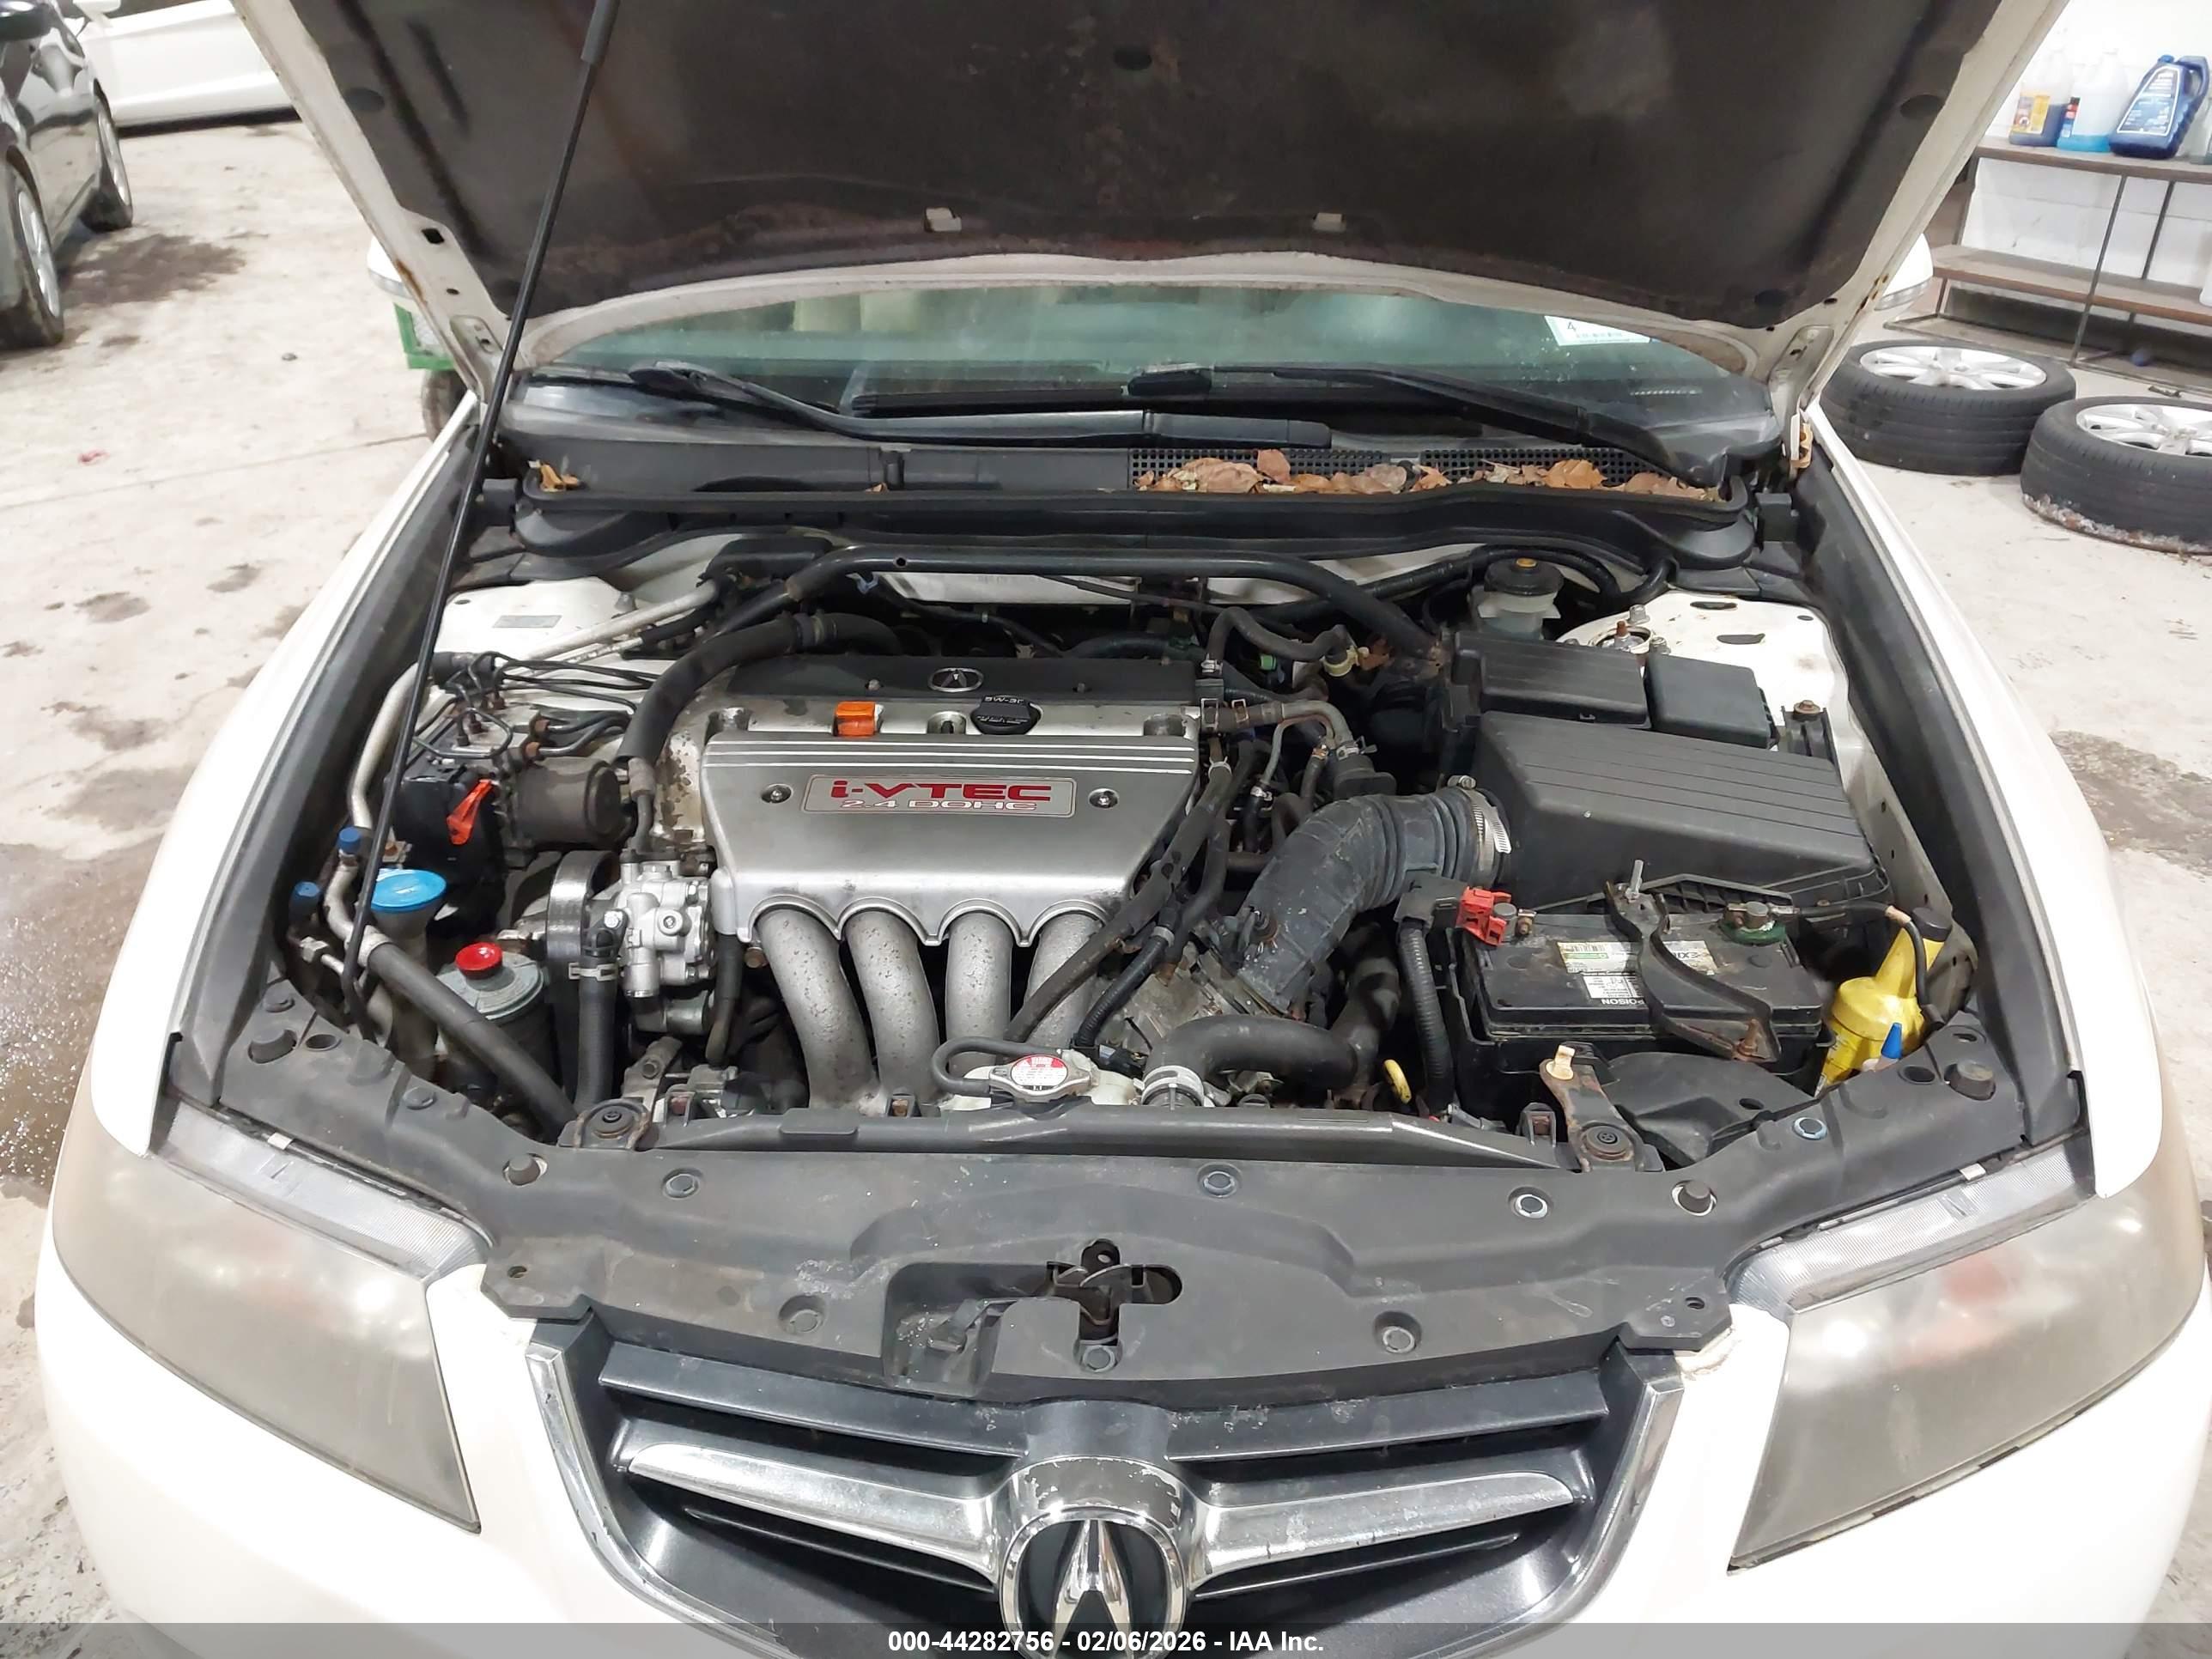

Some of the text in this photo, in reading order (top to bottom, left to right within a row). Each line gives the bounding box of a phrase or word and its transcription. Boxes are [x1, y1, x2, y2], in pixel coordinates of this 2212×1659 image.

[830, 780, 1052, 801] i-VTEC
[840, 799, 1037, 811] 2.4 DOHC
